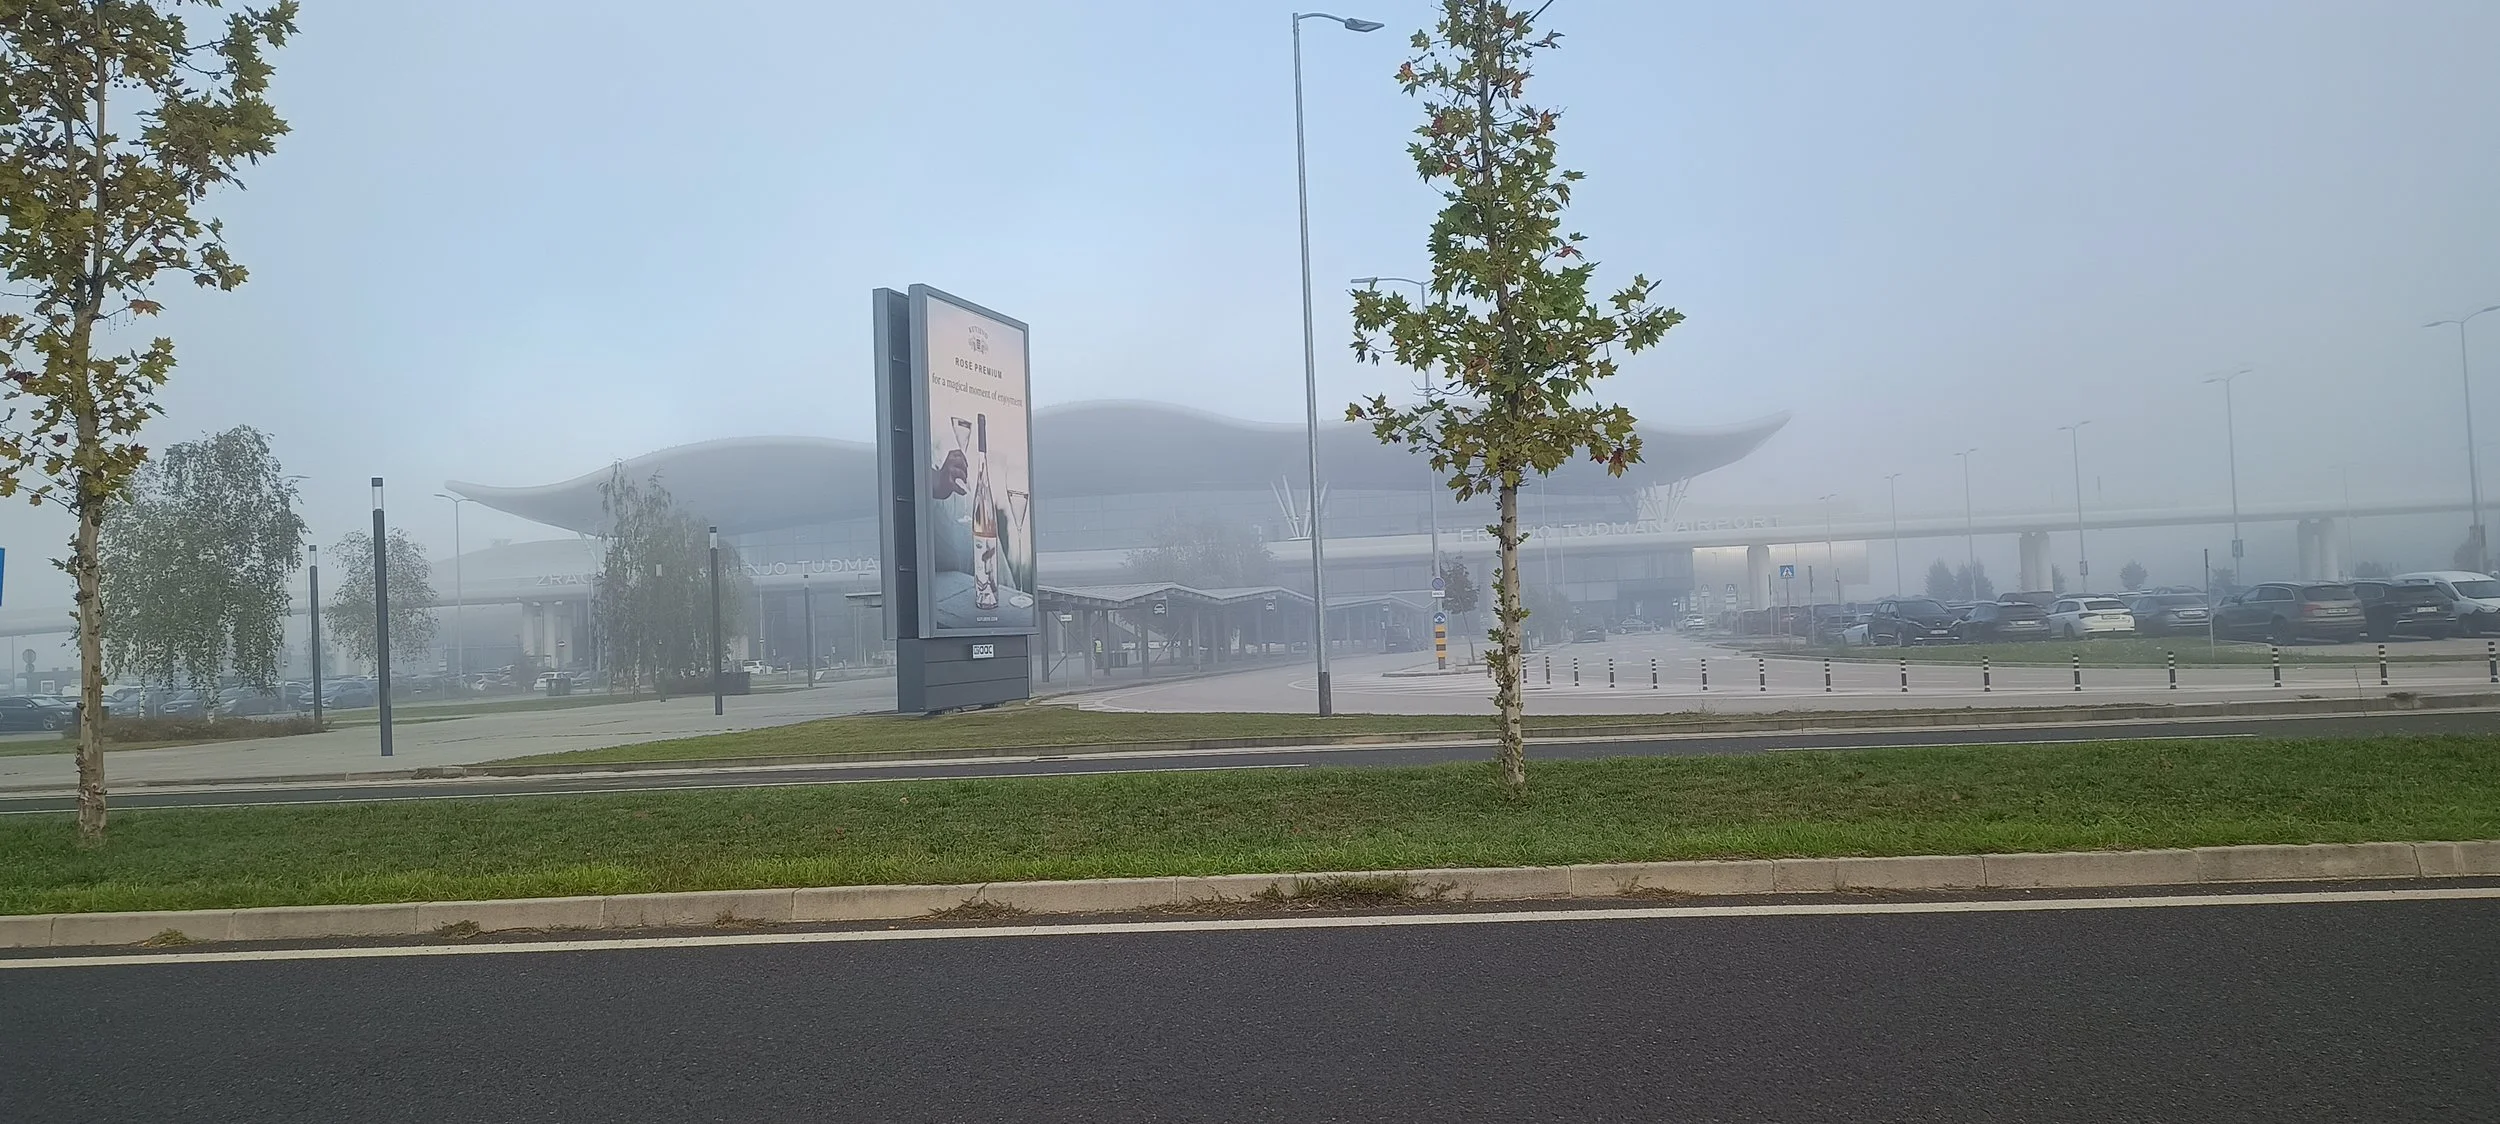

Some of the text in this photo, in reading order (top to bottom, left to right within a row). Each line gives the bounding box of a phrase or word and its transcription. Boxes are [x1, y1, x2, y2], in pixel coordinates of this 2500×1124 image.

[974, 363, 1002, 379] PREMIUM
[932, 372, 941, 384] for
[947, 380, 968, 393] magical
[969, 385, 991, 398] moment
[991, 390, 997, 400] of
[1460, 526, 1551, 542] FRJO
[1676, 515, 1785, 532] AIRPORT
[797, 557, 878, 573] TUĐMA
